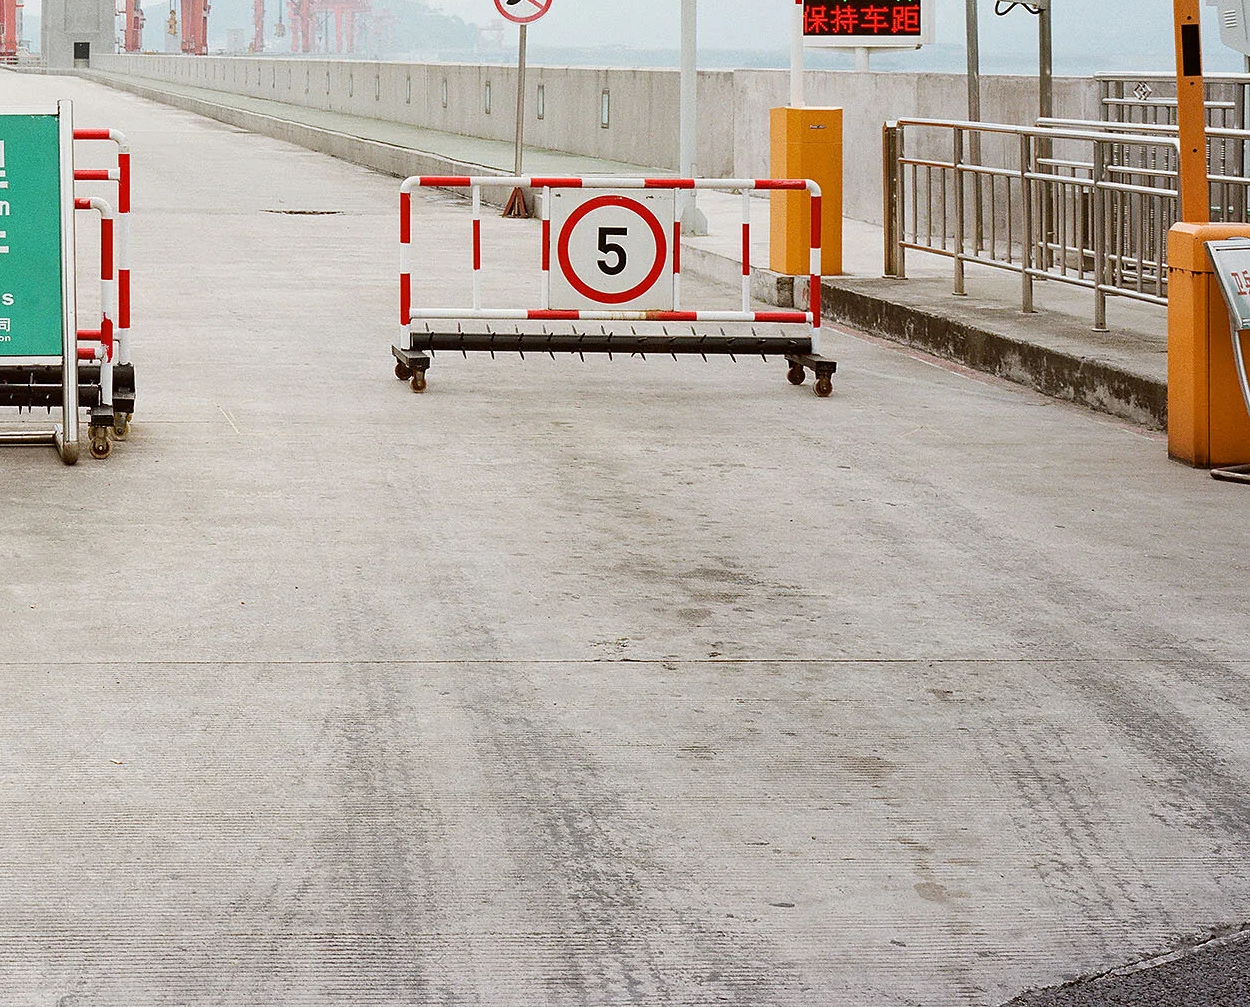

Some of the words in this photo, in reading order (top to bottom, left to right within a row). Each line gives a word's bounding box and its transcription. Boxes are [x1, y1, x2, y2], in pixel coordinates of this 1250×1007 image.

[803, 4, 920, 33] 保持车距
[597, 227, 628, 275] 5
